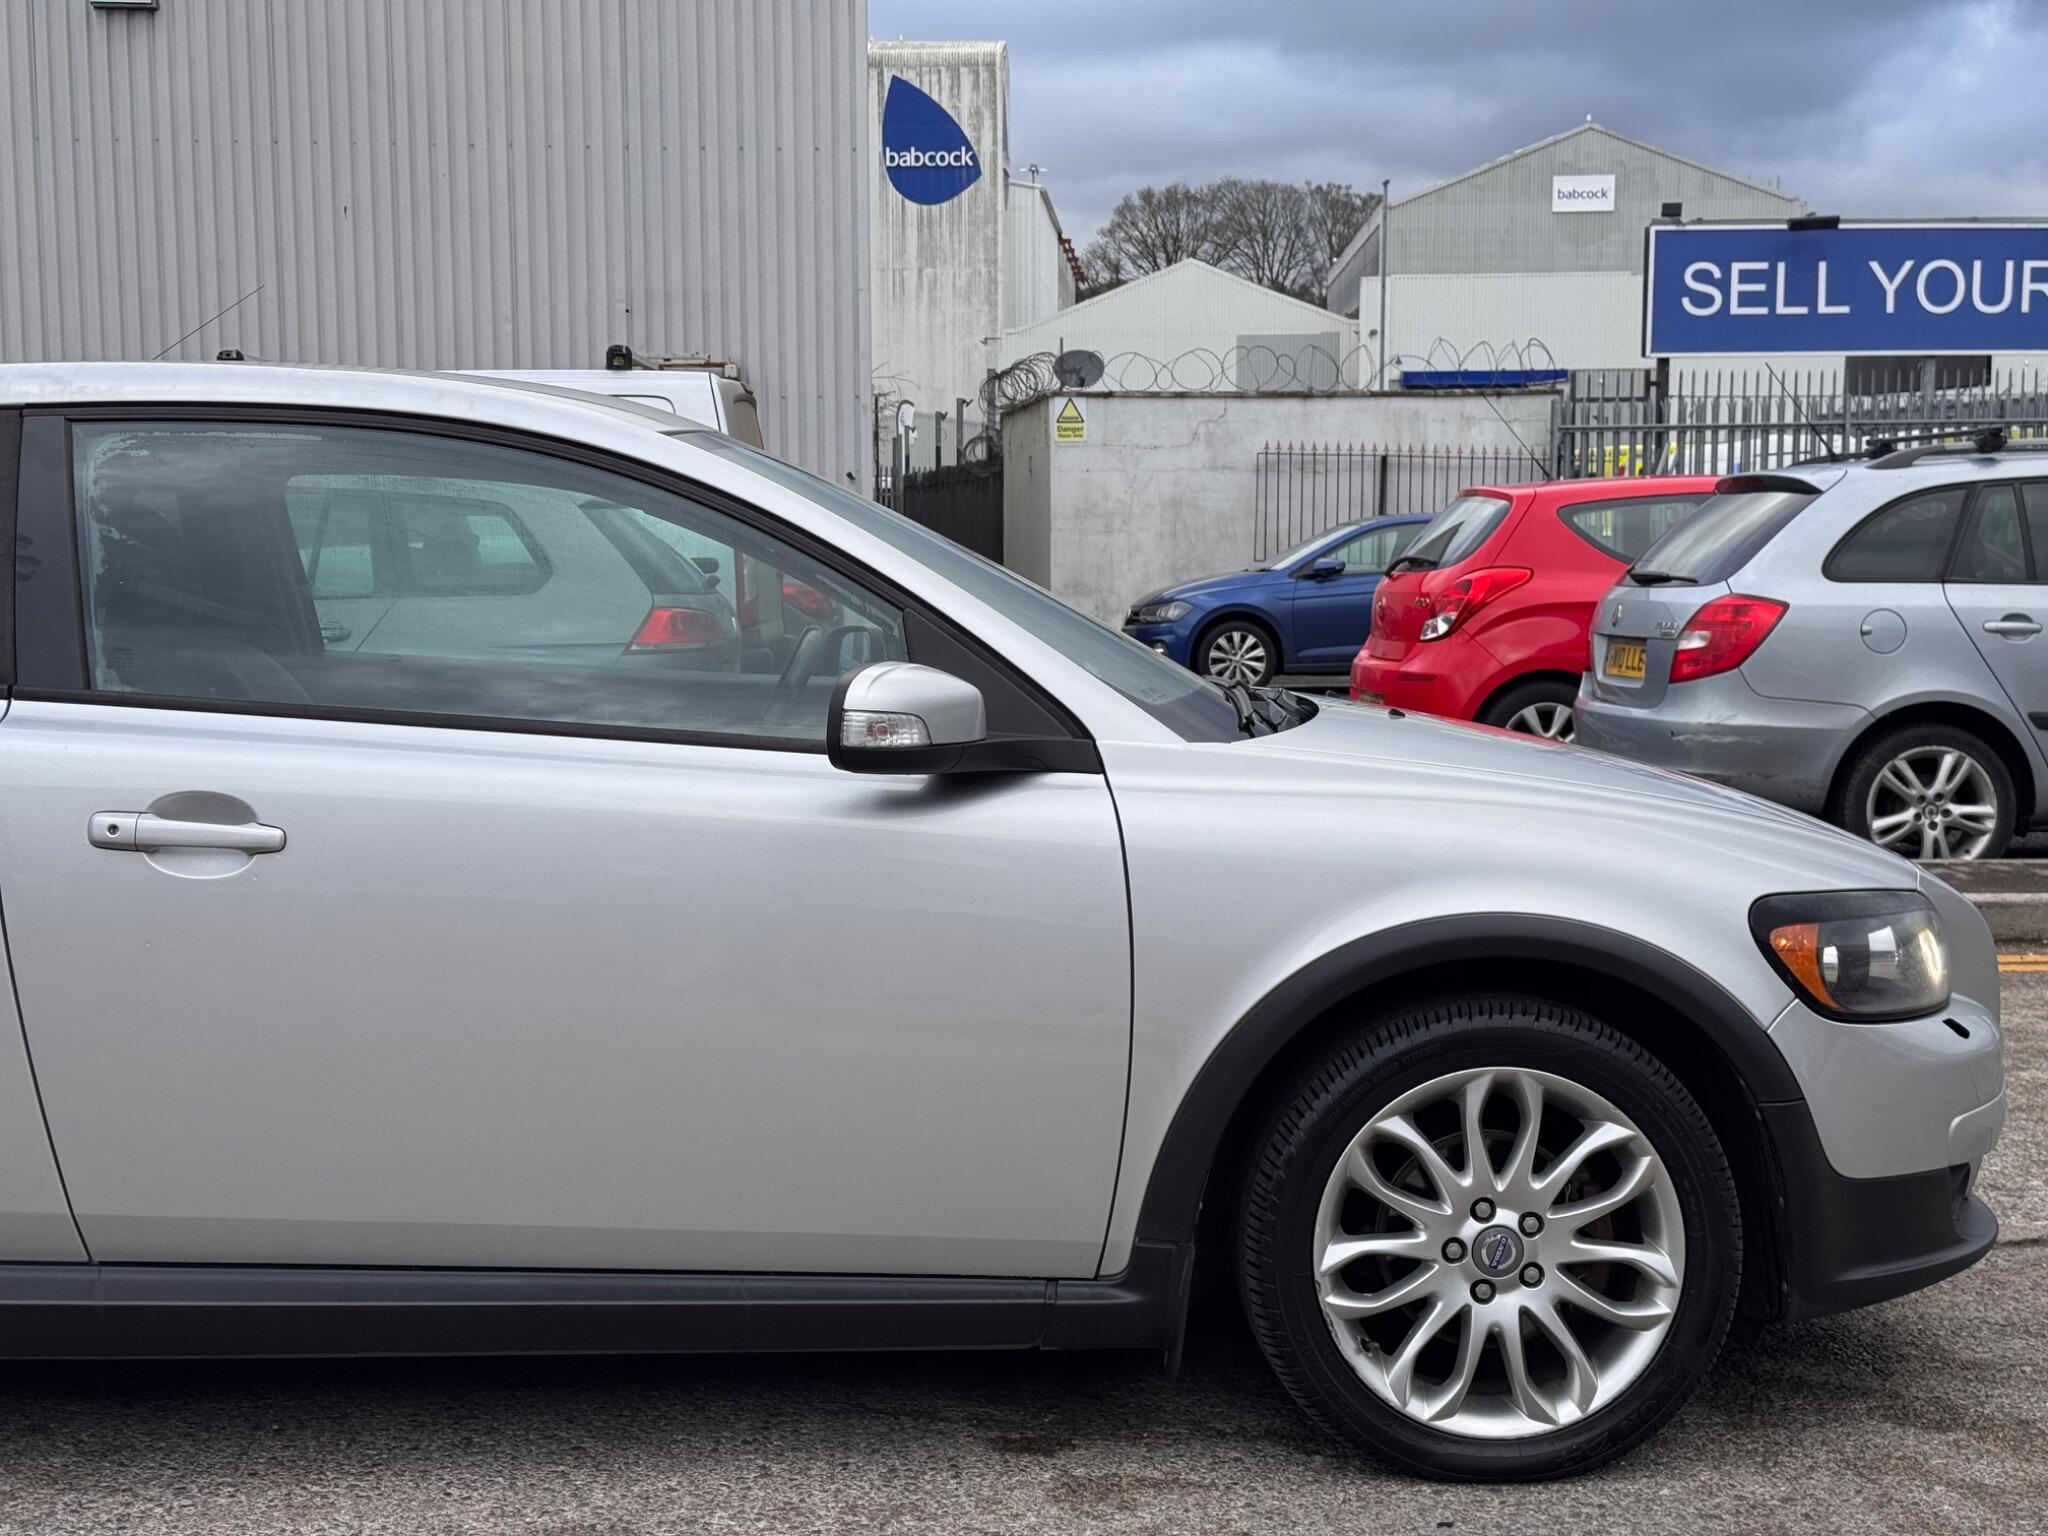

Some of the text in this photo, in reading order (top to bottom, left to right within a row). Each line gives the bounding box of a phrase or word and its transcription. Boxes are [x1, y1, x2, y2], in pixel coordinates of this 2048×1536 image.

[885, 146, 974, 167] babcock
[1557, 187, 1608, 200] babcock
[1681, 260, 1851, 317] SELL
[1491, 1237, 1507, 1267] VOLVO
